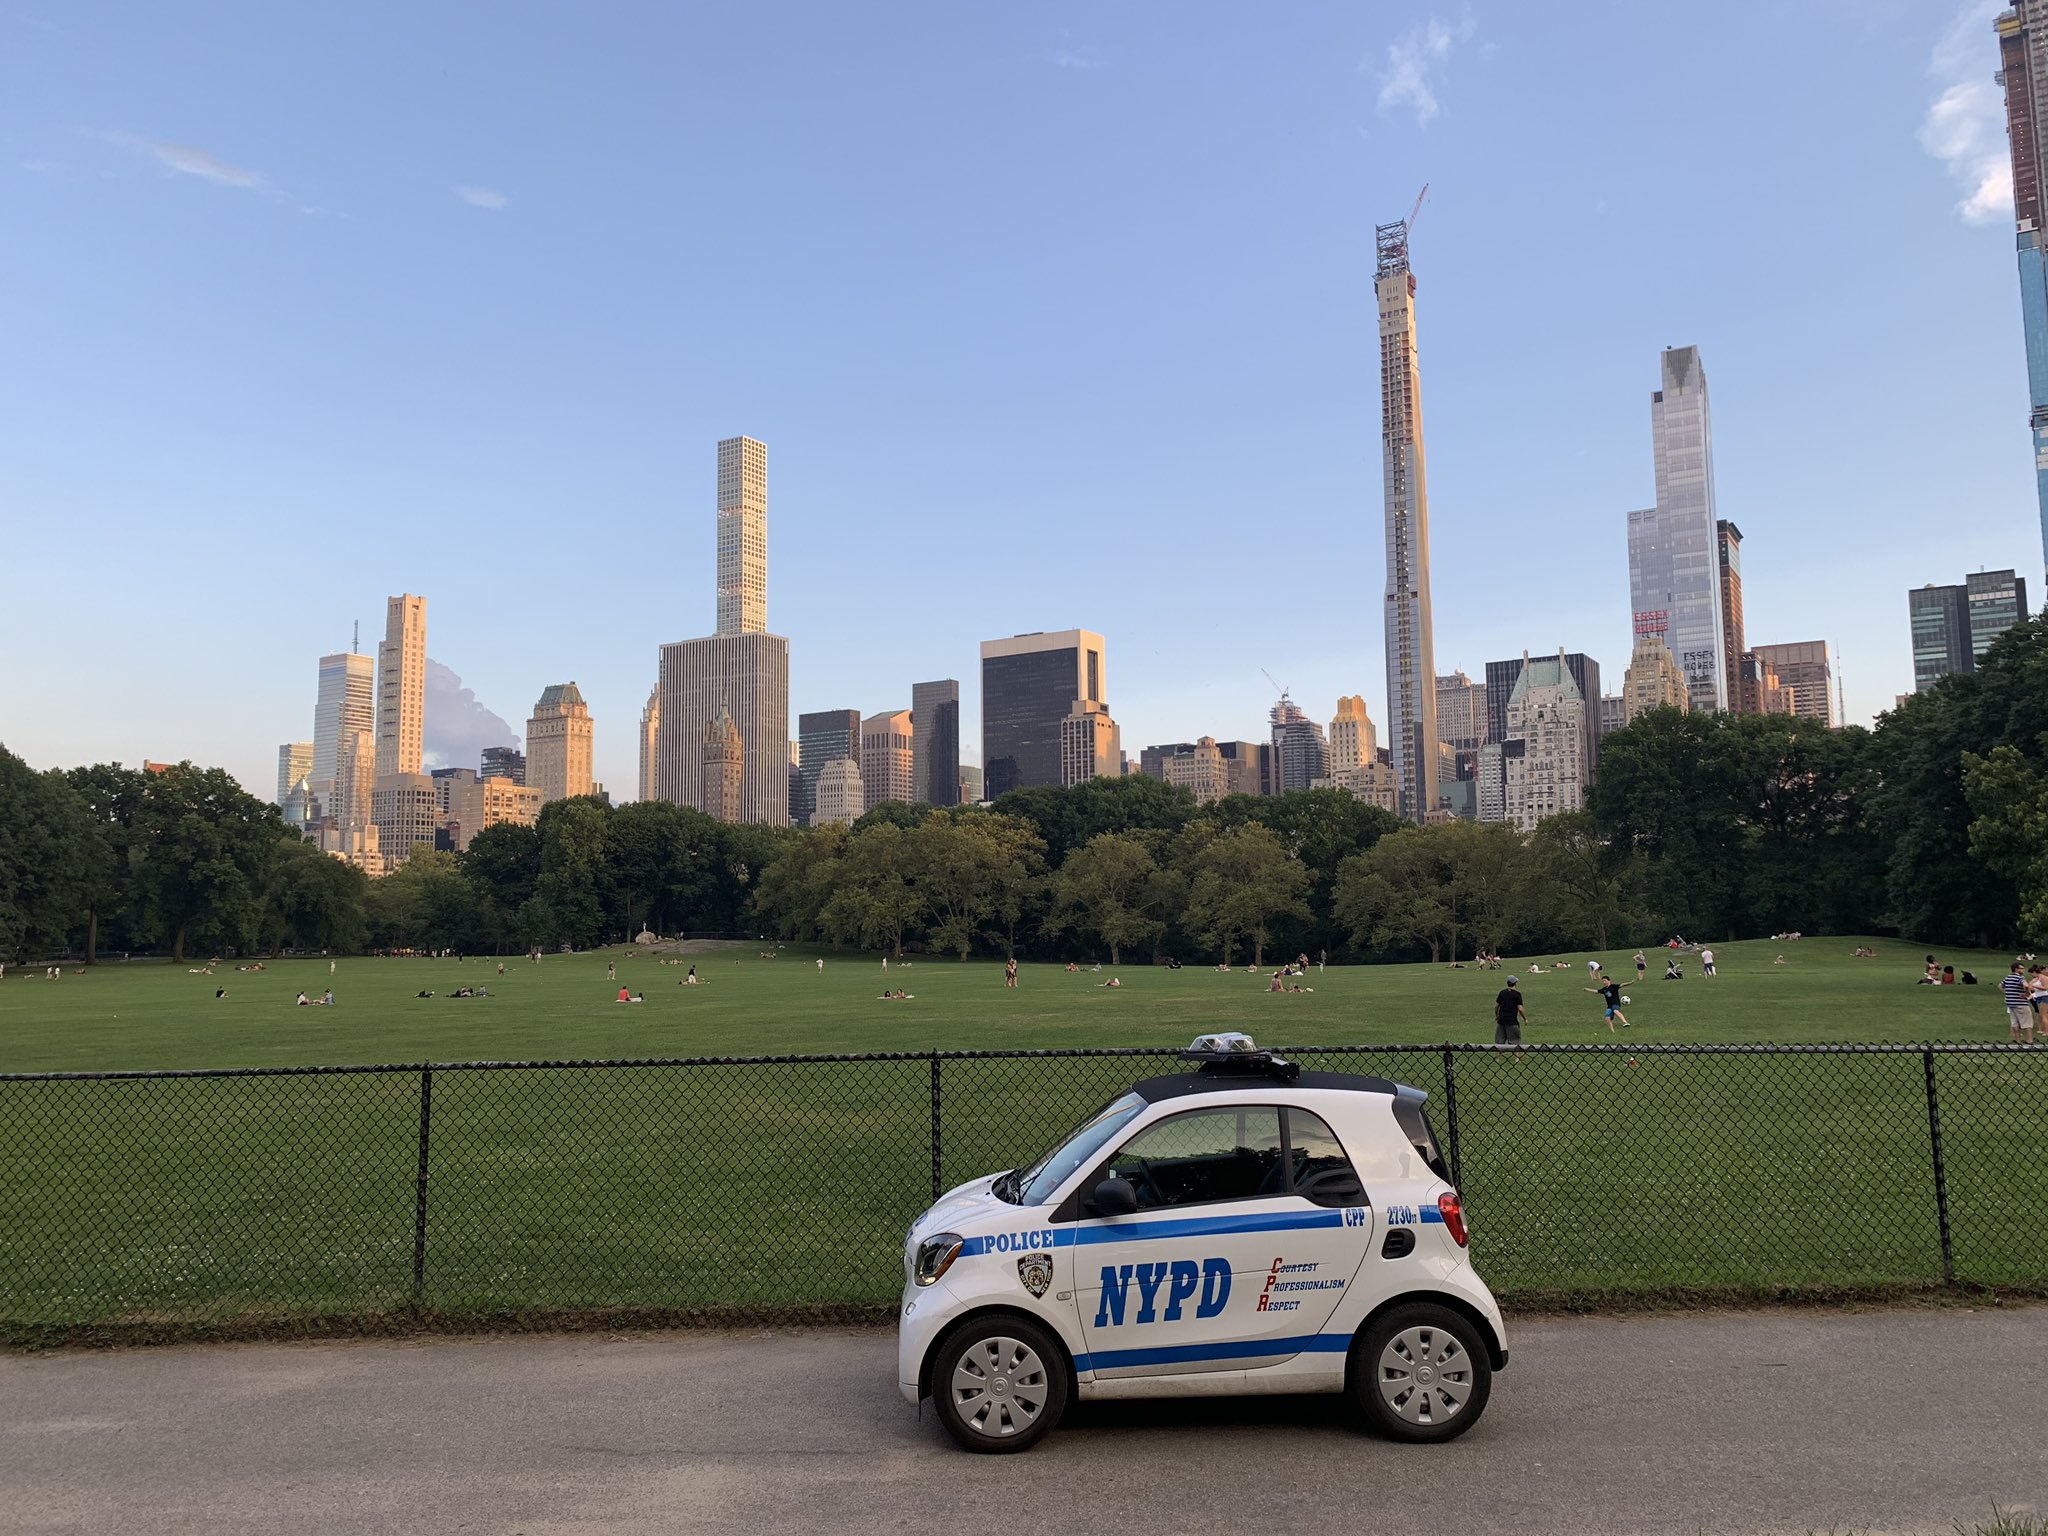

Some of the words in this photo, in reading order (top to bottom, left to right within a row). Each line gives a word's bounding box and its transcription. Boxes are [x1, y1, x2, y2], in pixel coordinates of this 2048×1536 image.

[1345, 1208, 1365, 1227] CPP
[1387, 1206, 1412, 1225] 2730
[984, 1230, 1052, 1254] POLICE
[1019, 1259, 1051, 1270] DEPARTMENT
[1094, 1257, 1232, 1328] NYPD
[1264, 1275, 1346, 1293] PROFESSIONALISM
[1256, 1294, 1300, 1312] RESPECT
